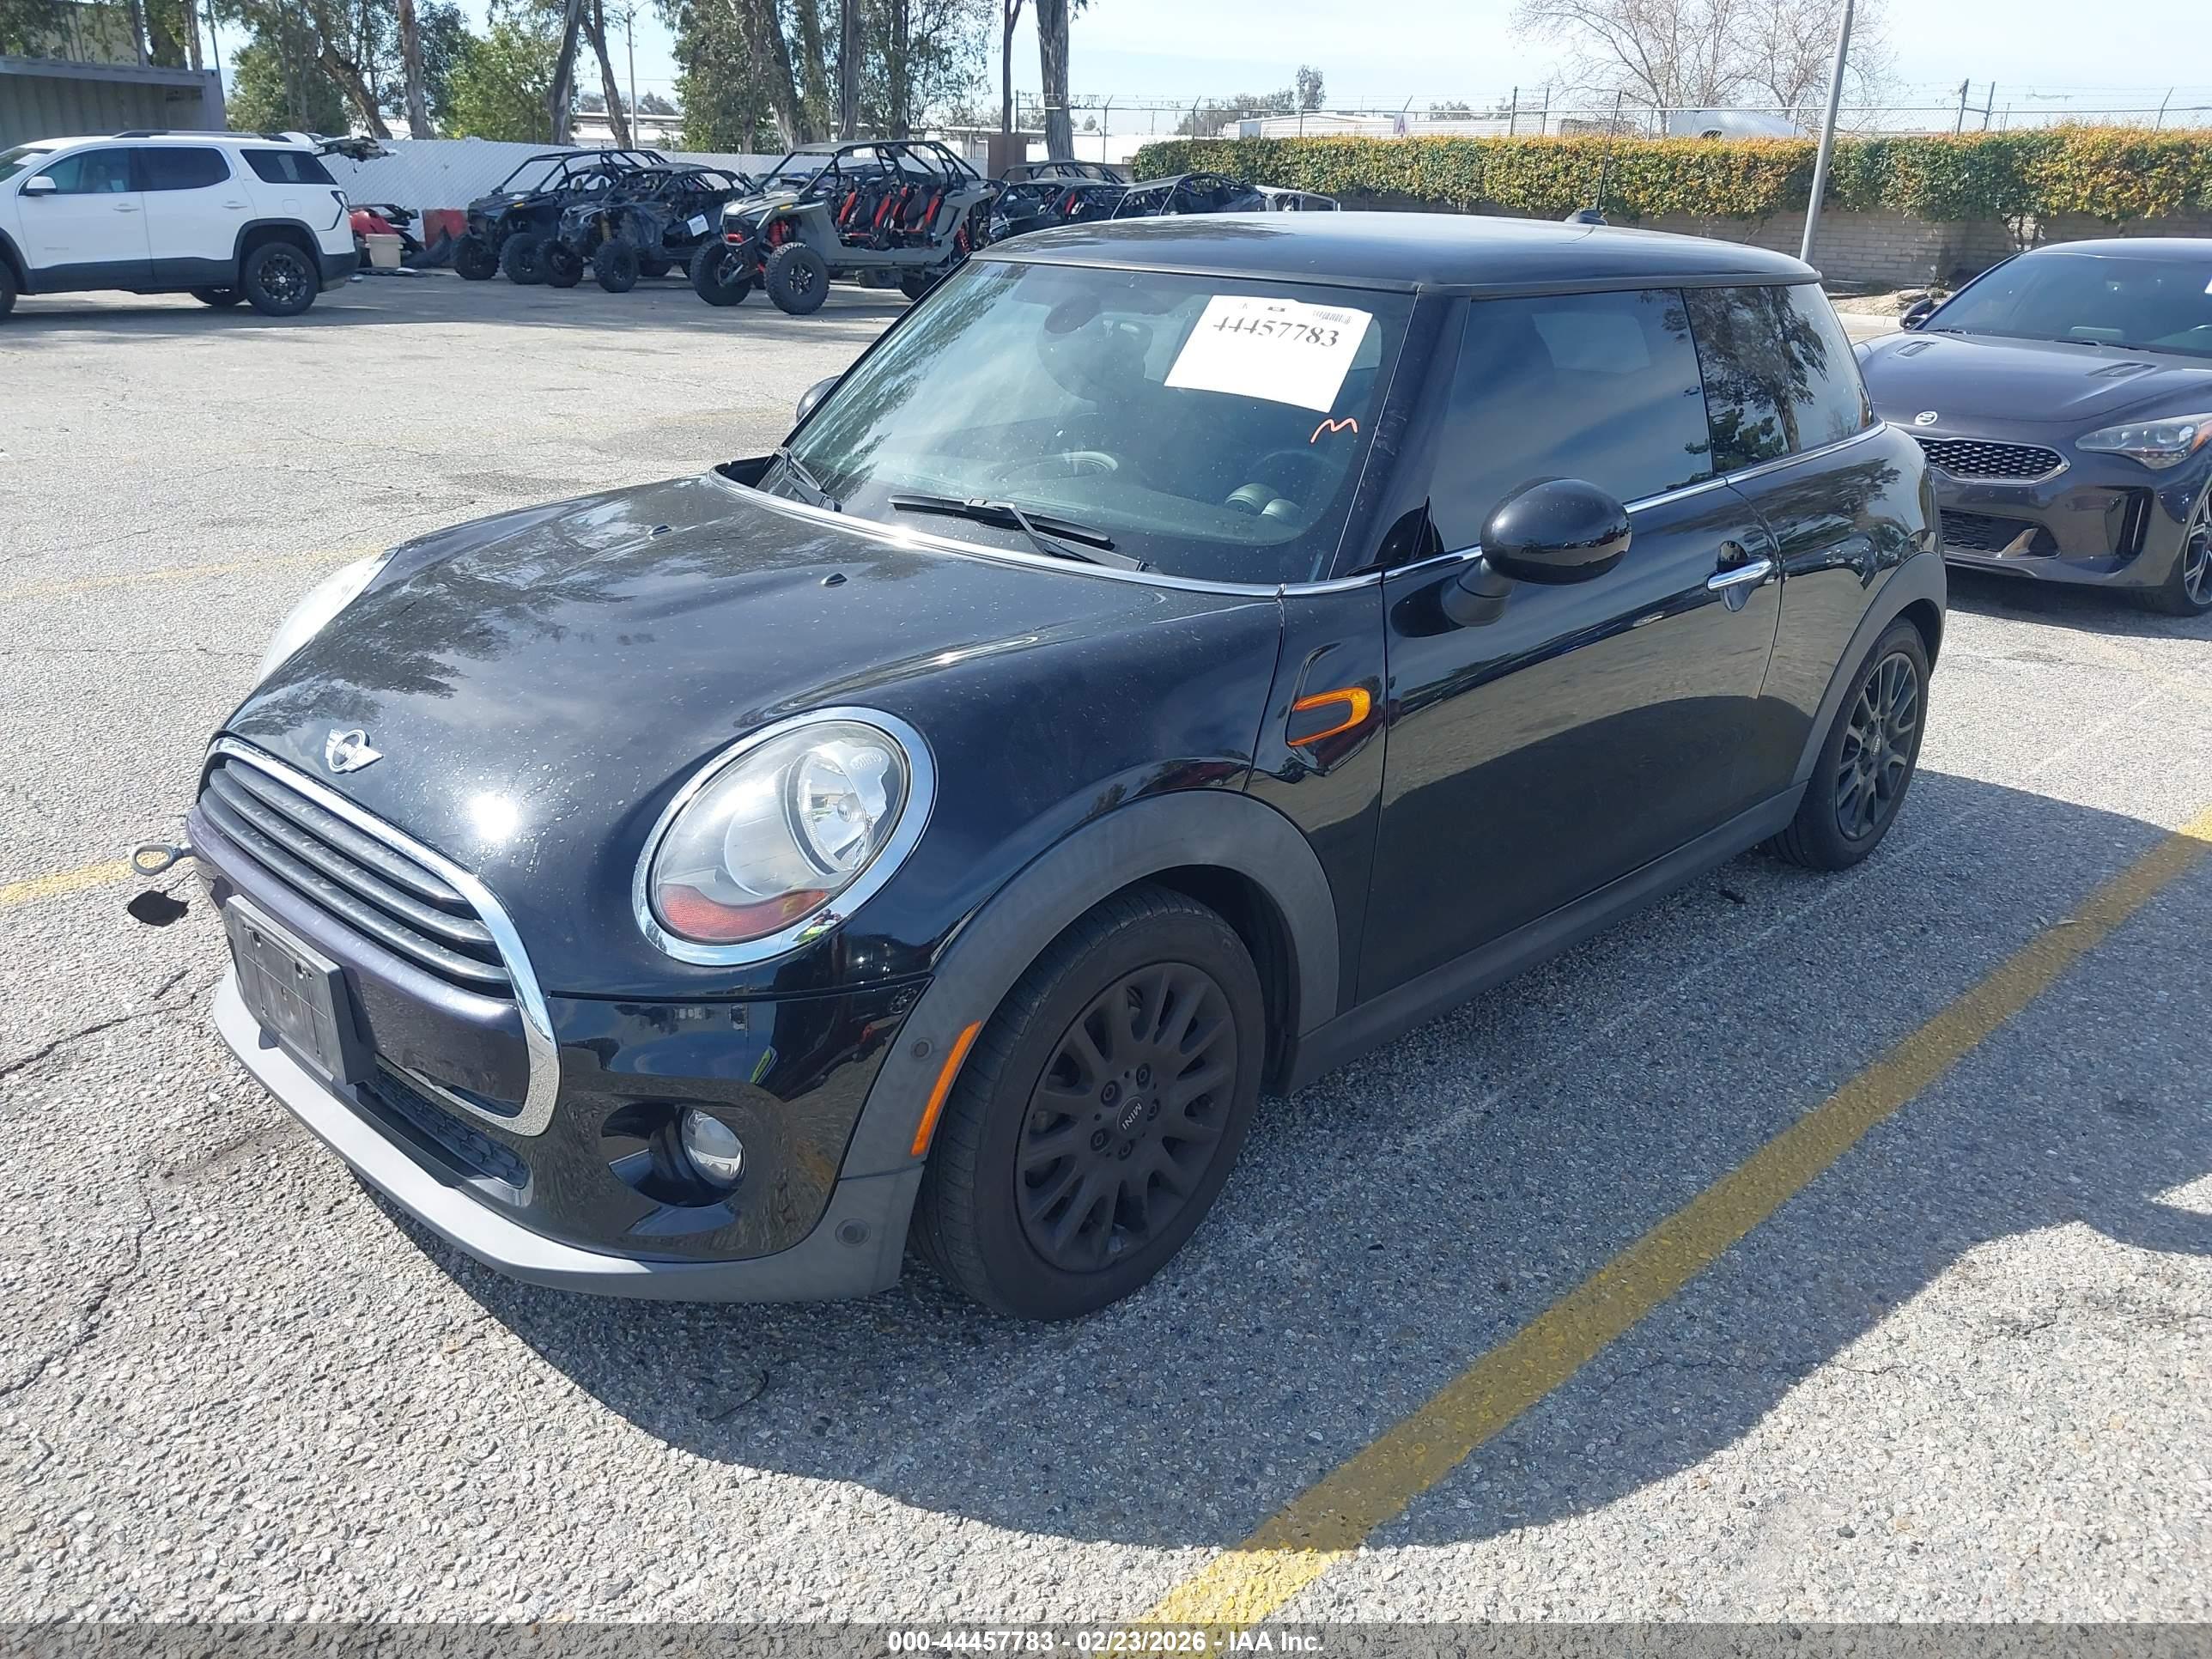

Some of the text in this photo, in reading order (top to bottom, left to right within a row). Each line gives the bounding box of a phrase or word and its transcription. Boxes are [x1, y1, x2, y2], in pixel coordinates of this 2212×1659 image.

[1397, 113, 1406, 133] A
[1212, 315, 1340, 347] 44457783
[1121, 1103, 1142, 1130] MINI
